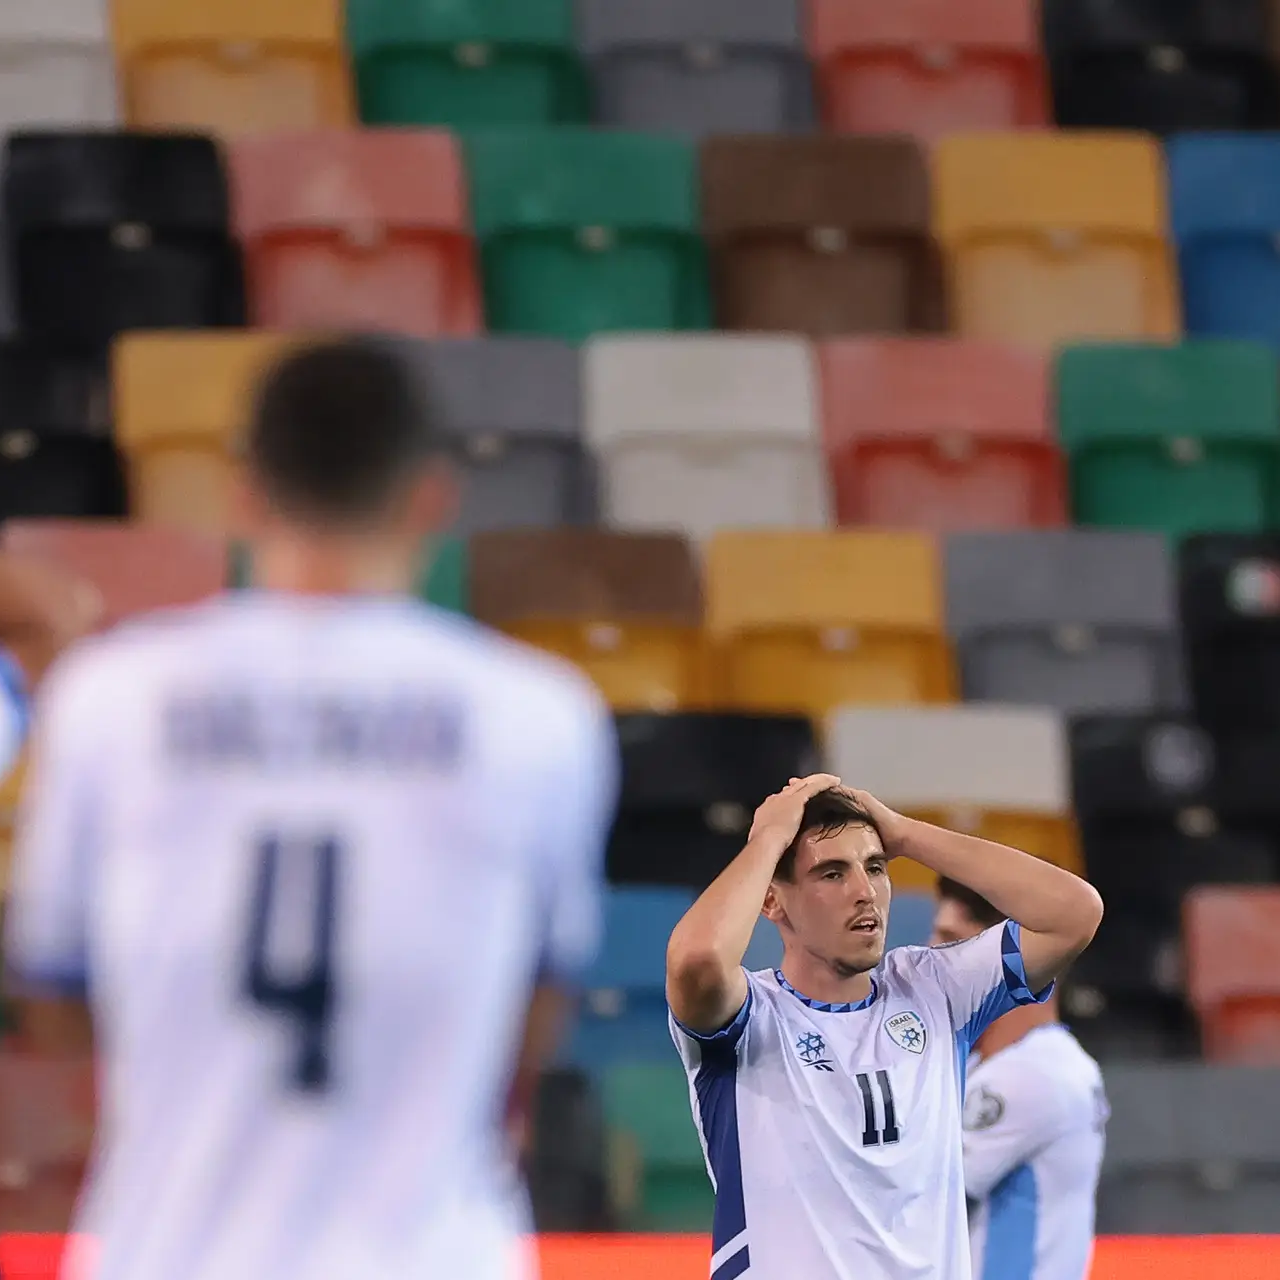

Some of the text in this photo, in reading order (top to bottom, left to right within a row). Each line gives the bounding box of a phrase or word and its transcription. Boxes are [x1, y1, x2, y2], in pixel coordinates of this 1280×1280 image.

[242, 832, 344, 1096] 4
[889, 1014, 913, 1028] ISRAEL
[855, 1069, 900, 1147] 11
